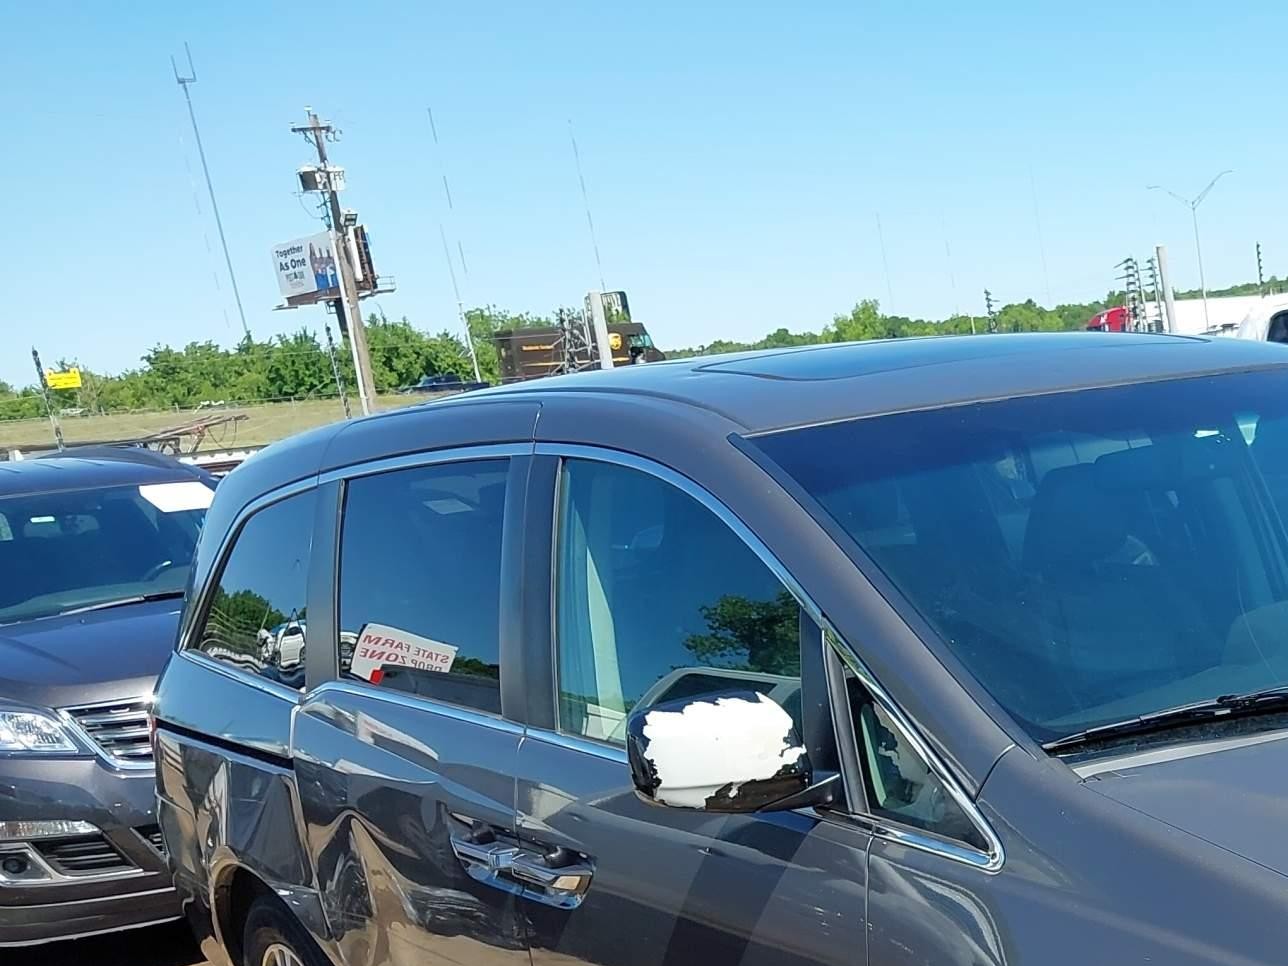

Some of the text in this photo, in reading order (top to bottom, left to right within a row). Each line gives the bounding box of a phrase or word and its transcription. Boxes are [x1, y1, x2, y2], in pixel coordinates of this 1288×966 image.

[275, 245, 303, 259] Together
[279, 257, 307, 272] As One
